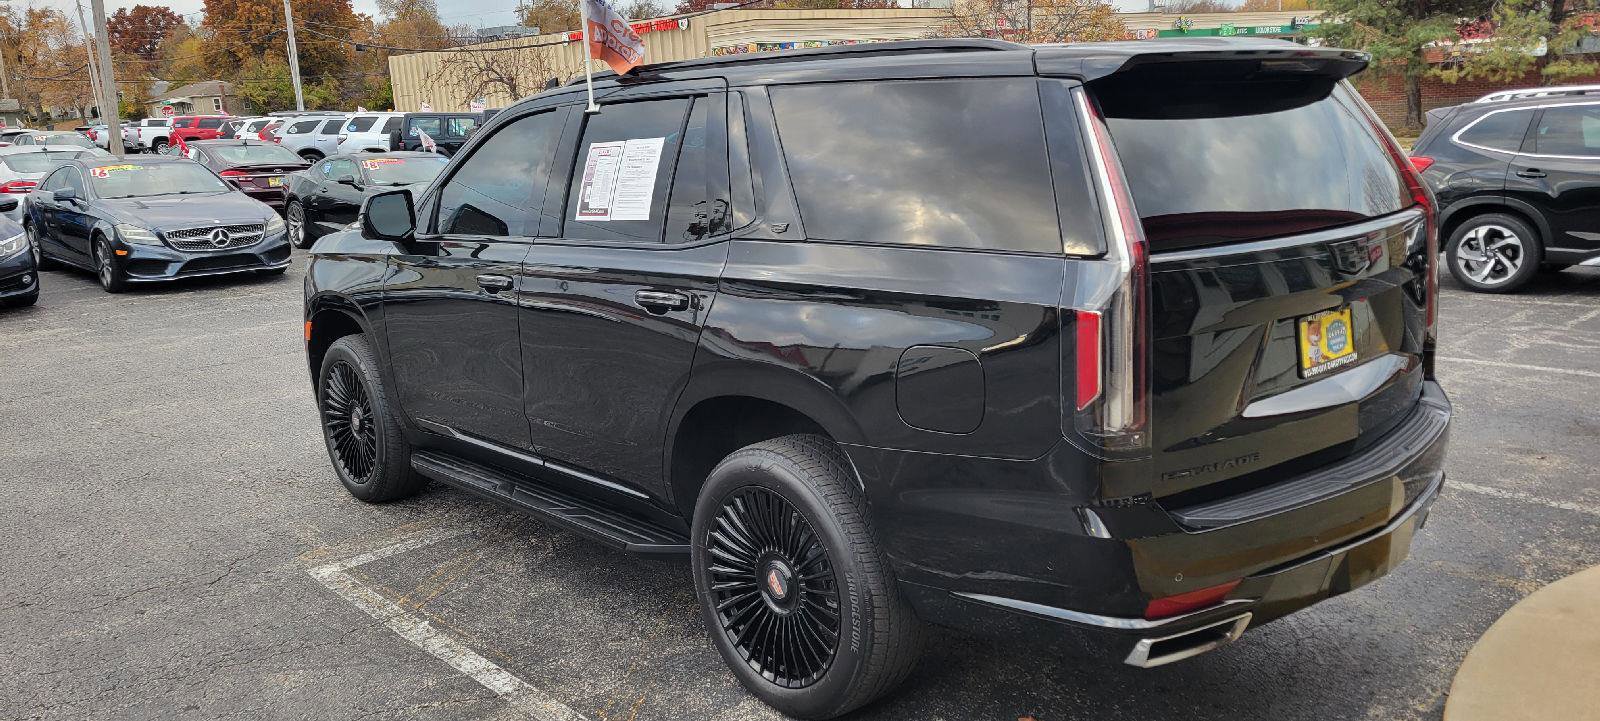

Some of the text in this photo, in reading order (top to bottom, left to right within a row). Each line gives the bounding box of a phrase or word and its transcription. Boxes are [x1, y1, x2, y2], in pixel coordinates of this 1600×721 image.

[92, 169, 107, 177] 16
[1161, 452, 1261, 480] ESCALADE
[844, 571, 861, 654] BRIDGESTONE
